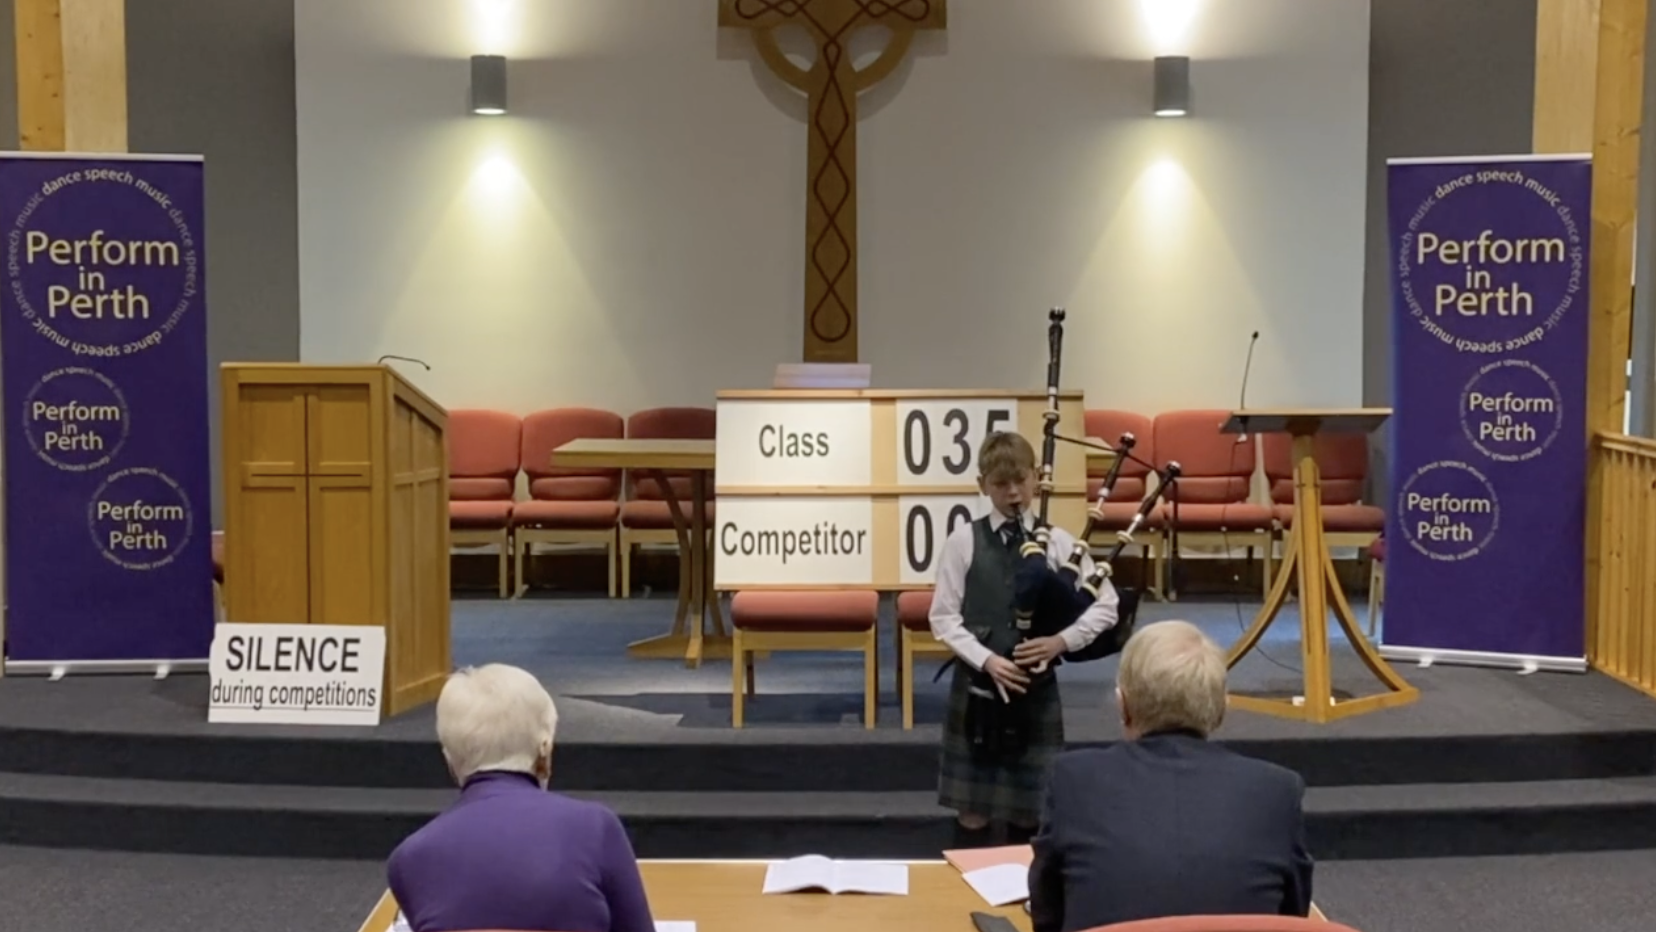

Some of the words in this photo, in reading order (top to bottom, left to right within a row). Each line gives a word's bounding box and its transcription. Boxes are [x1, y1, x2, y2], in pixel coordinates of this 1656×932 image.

[42, 170, 82, 196] dance
[84, 168, 134, 185] speech
[1435, 173, 1474, 199] dance
[1476, 170, 1524, 186] speech
[135, 179, 173, 209] music
[1524, 178, 1561, 207] music
[26, 230, 179, 266] Perform
[1417, 229, 1565, 265] Perform
[79, 266, 105, 291] in
[1466, 265, 1490, 289] in
[48, 285, 149, 319] Perth
[1435, 282, 1533, 316] Perth
[32, 318, 70, 347] music
[1419, 315, 1454, 345] music
[1506, 327, 1545, 350] dance
[72, 341, 121, 357] speech
[123, 331, 162, 354] dance
[1456, 338, 1503, 353] speech
[33, 400, 120, 421] Perform
[1469, 391, 1553, 413] Perform
[62, 420, 77, 435] in
[1497, 412, 1512, 425] in
[44, 431, 103, 450] Perth
[758, 424, 830, 458] Class
[1479, 421, 1536, 442] Perth
[97, 500, 184, 521] Perform
[1407, 492, 1490, 513] Perform
[127, 521, 143, 534] in
[1434, 511, 1449, 525] in
[109, 530, 167, 550] Perth
[720, 521, 867, 564] Competitor
[1417, 521, 1473, 542] Perth
[225, 635, 361, 673] SILENCE
[211, 678, 264, 711] during
[269, 680, 376, 711] competitions
